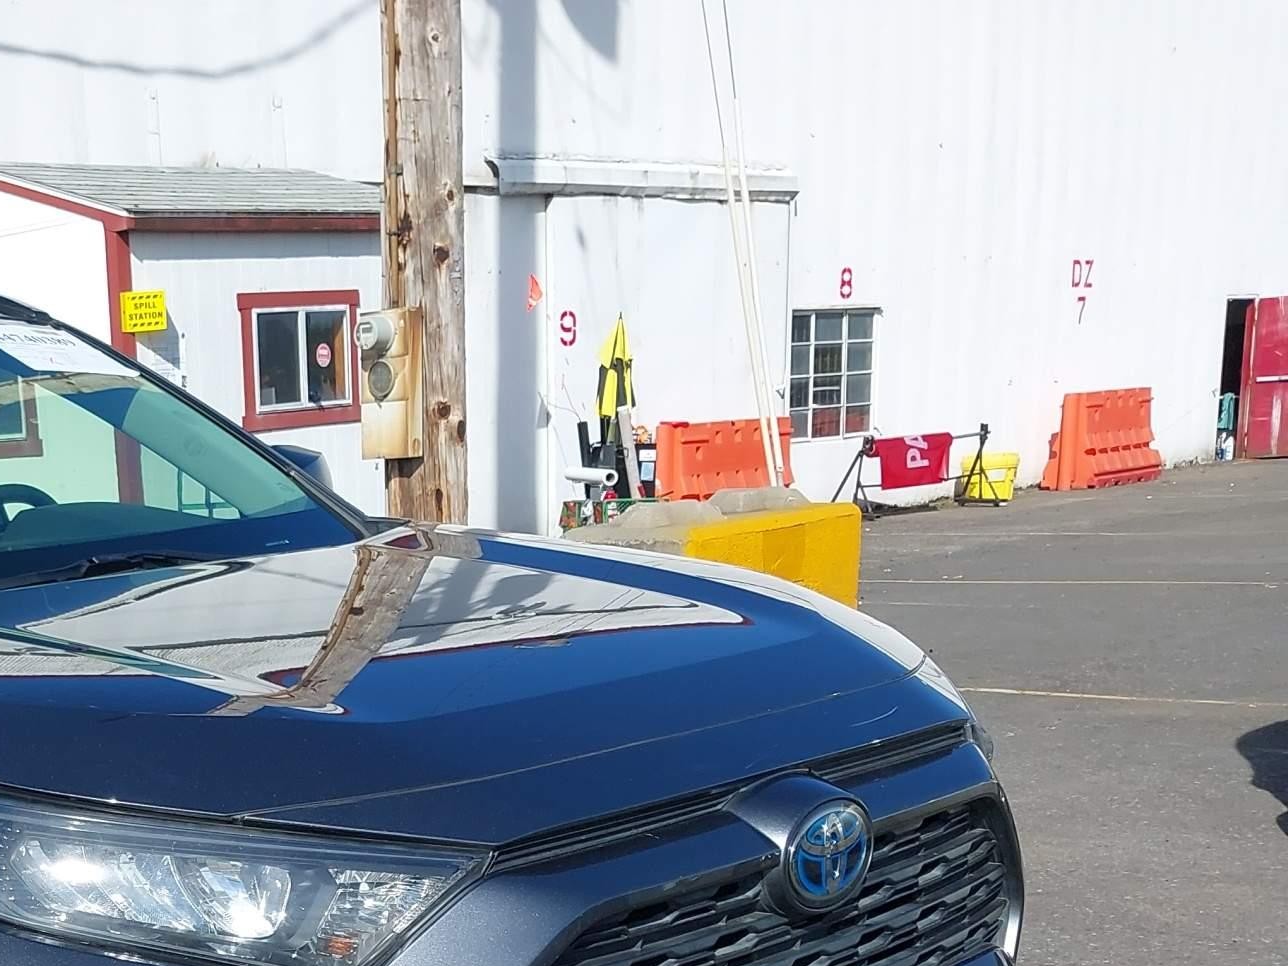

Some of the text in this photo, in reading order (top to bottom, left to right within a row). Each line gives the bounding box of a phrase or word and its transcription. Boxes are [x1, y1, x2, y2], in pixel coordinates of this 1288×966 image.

[839, 267, 852, 299] 8
[1072, 260, 1094, 288] DZ
[128, 311, 164, 321] STATION
[134, 301, 158, 310] SPILL
[1077, 296, 1086, 325] 7
[560, 310, 577, 347] 9
